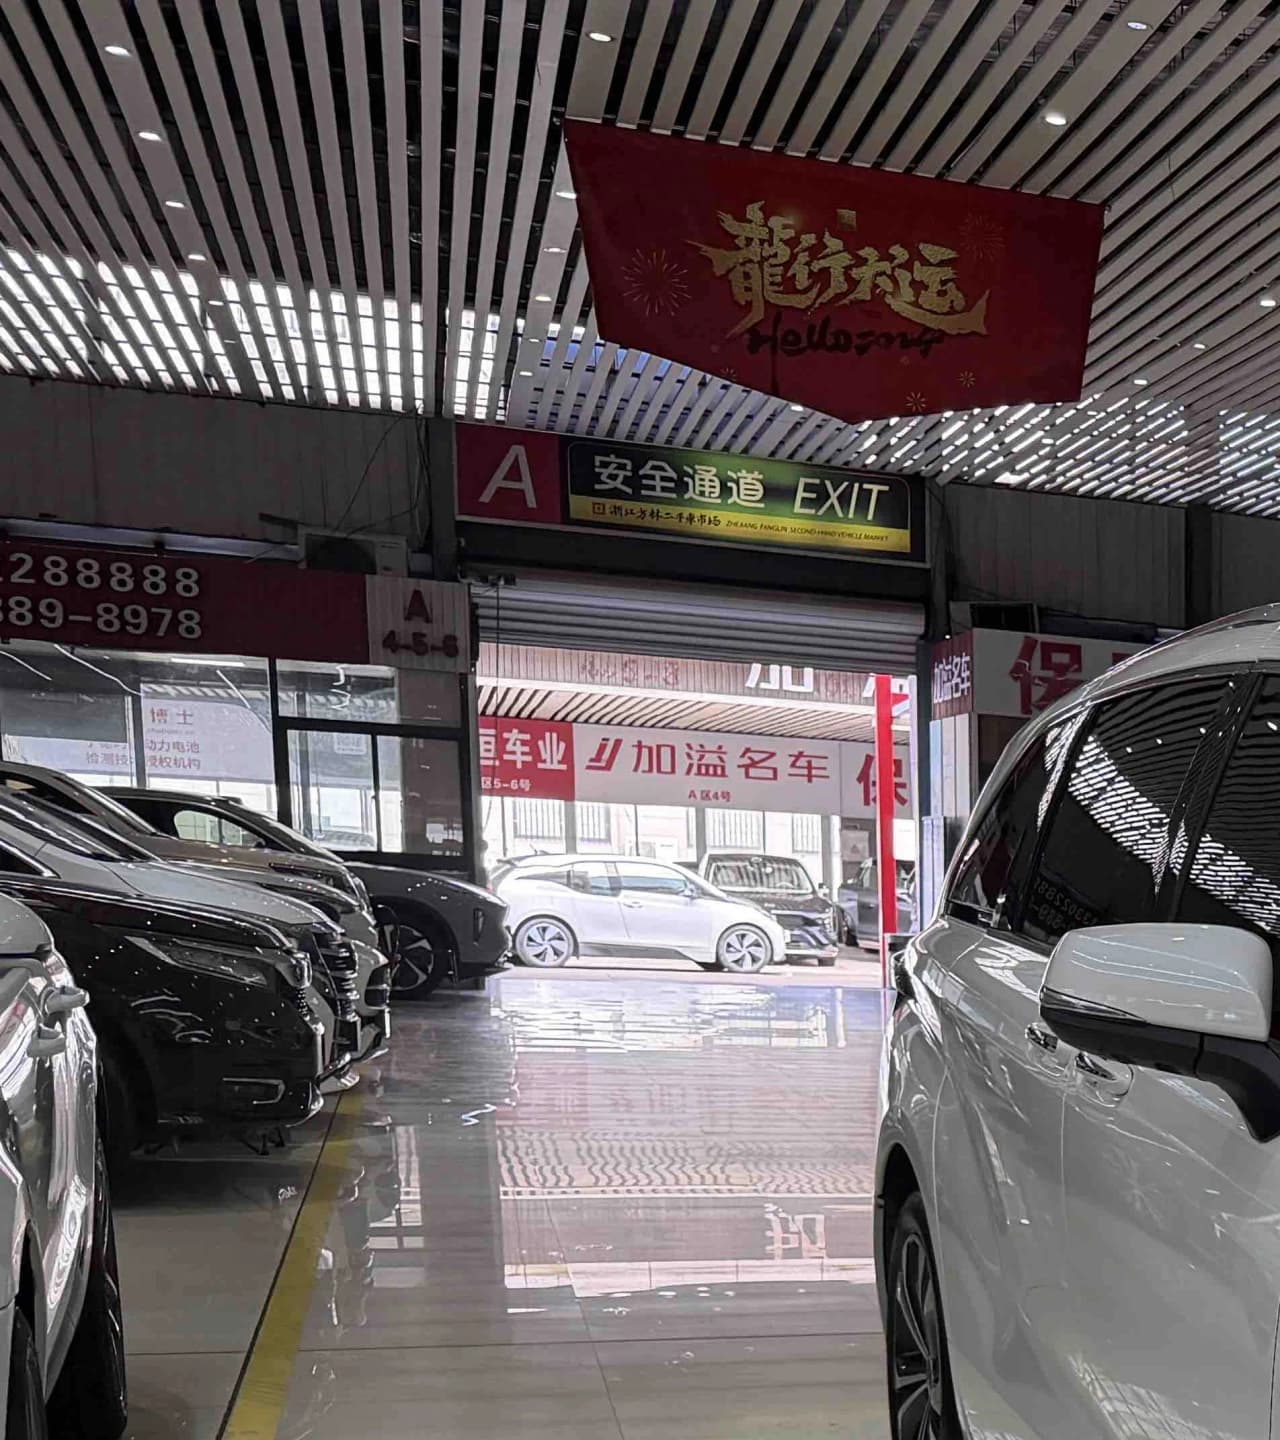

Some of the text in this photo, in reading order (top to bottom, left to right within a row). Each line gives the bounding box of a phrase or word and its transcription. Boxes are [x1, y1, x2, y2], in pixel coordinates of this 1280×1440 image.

[478, 444, 537, 509] A
[594, 454, 765, 508] 安全通道
[793, 477, 890, 521] EXIT
[0, 553, 200, 597] 288888
[0, 596, 201, 639] 89-8978
[403, 588, 432, 624] A
[382, 629, 459, 658] 4-5-6
[632, 739, 830, 784] 加溢名车
